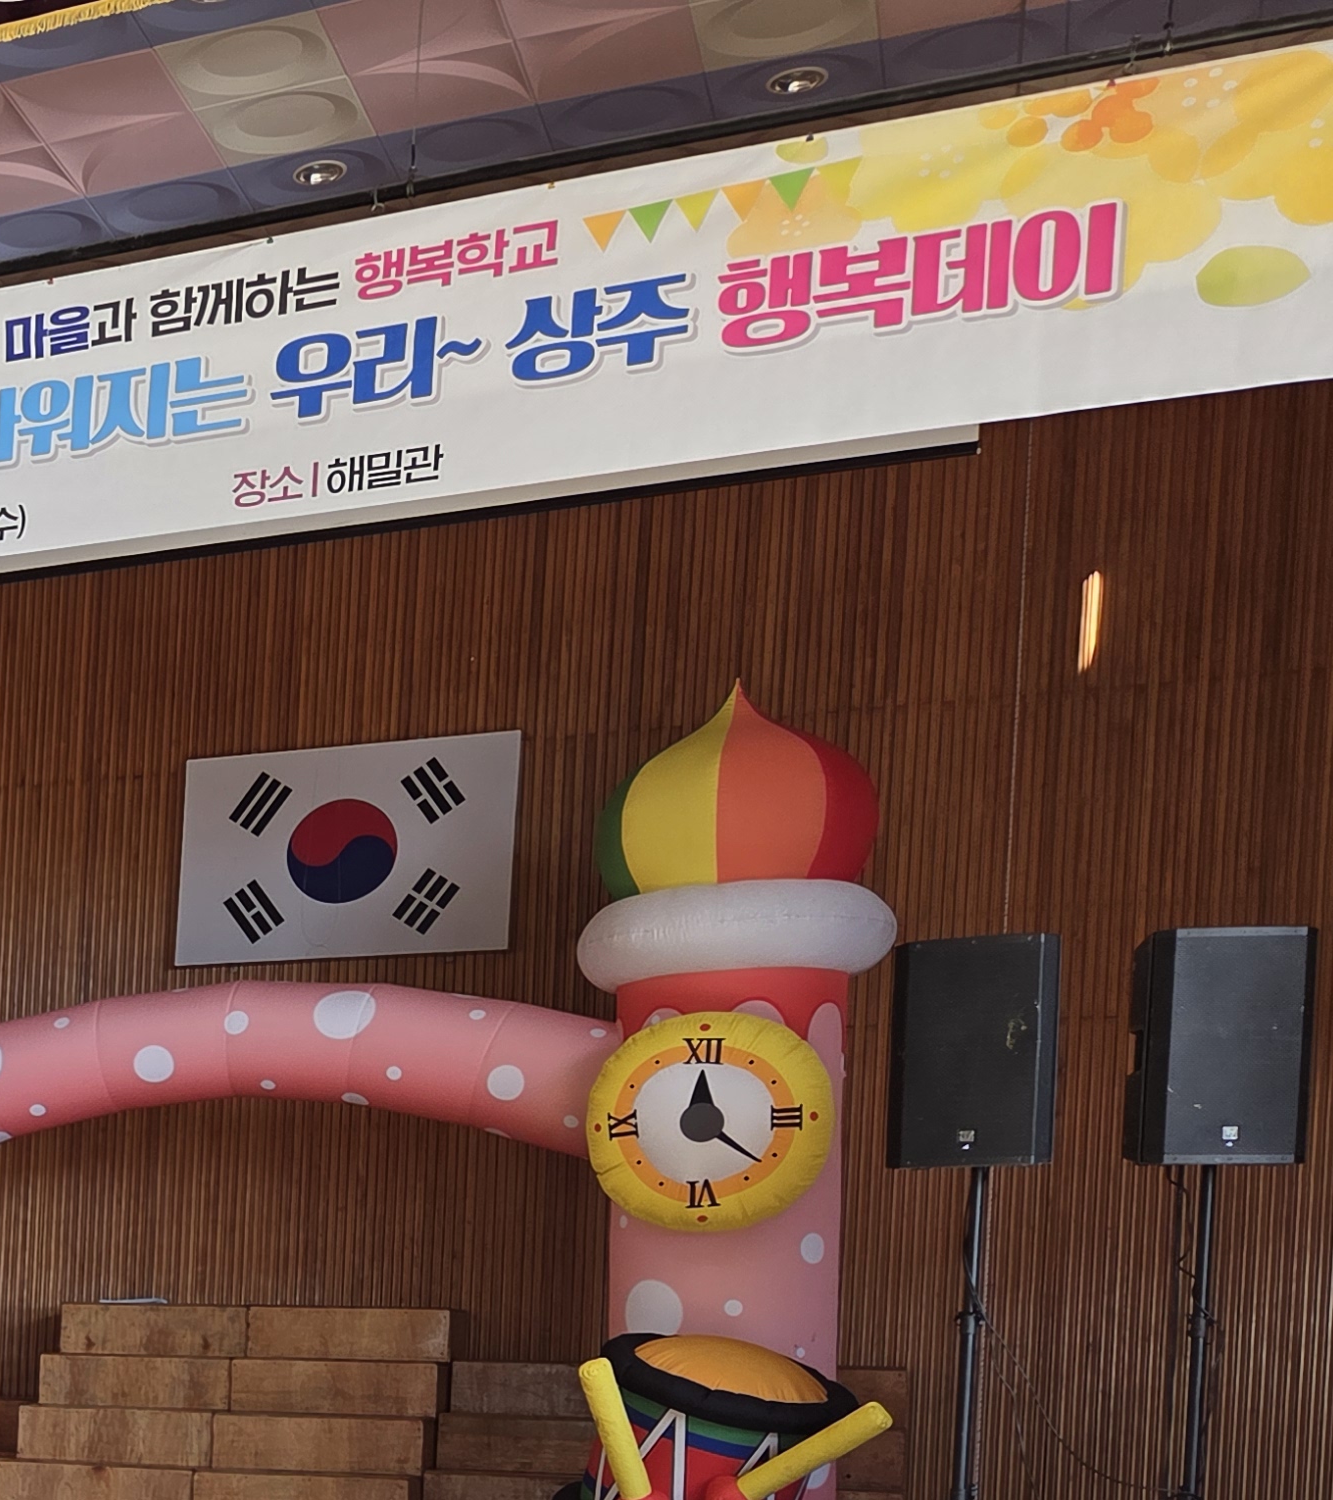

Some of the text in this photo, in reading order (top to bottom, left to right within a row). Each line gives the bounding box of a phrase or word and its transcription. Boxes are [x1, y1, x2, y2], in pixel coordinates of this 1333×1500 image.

[5, 298, 137, 362] 마을과
[150, 266, 341, 338] 함께하는
[354, 219, 560, 300] 행복학교
[269, 315, 483, 419] 우리~
[505, 273, 691, 381] 상주
[717, 202, 1118, 348] 행복데이
[232, 443, 445, 508] 장소 해밀관
